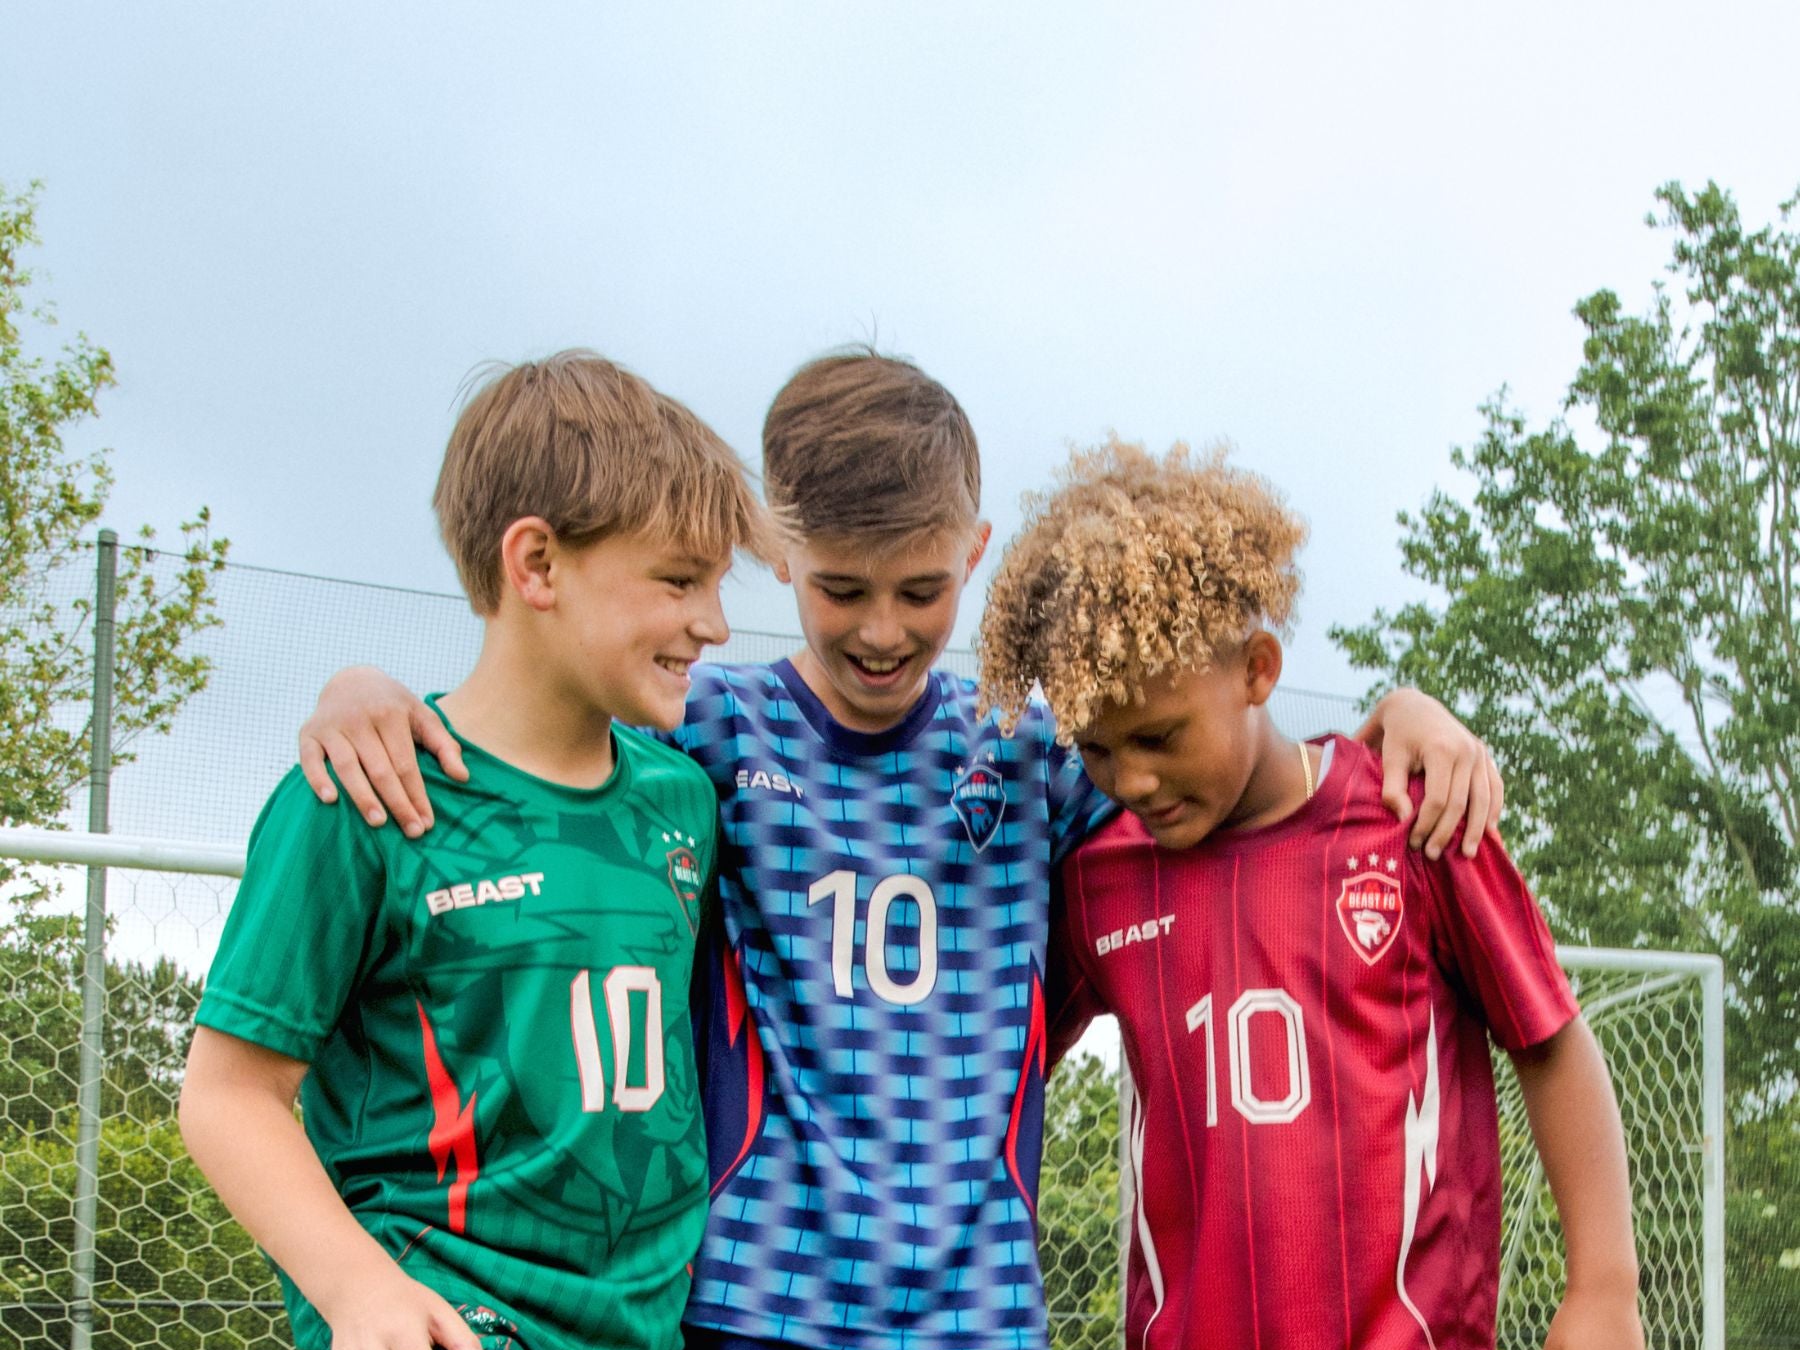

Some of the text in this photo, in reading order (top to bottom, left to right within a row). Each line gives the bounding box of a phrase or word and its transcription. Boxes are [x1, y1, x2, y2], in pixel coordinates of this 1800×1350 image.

[735, 768, 805, 800] EAST
[425, 872, 545, 917] BEAST
[807, 869, 939, 1006] 10
[1095, 914, 1176, 957] BEAST
[569, 966, 666, 1113] 10
[1185, 987, 1312, 1128] 10
